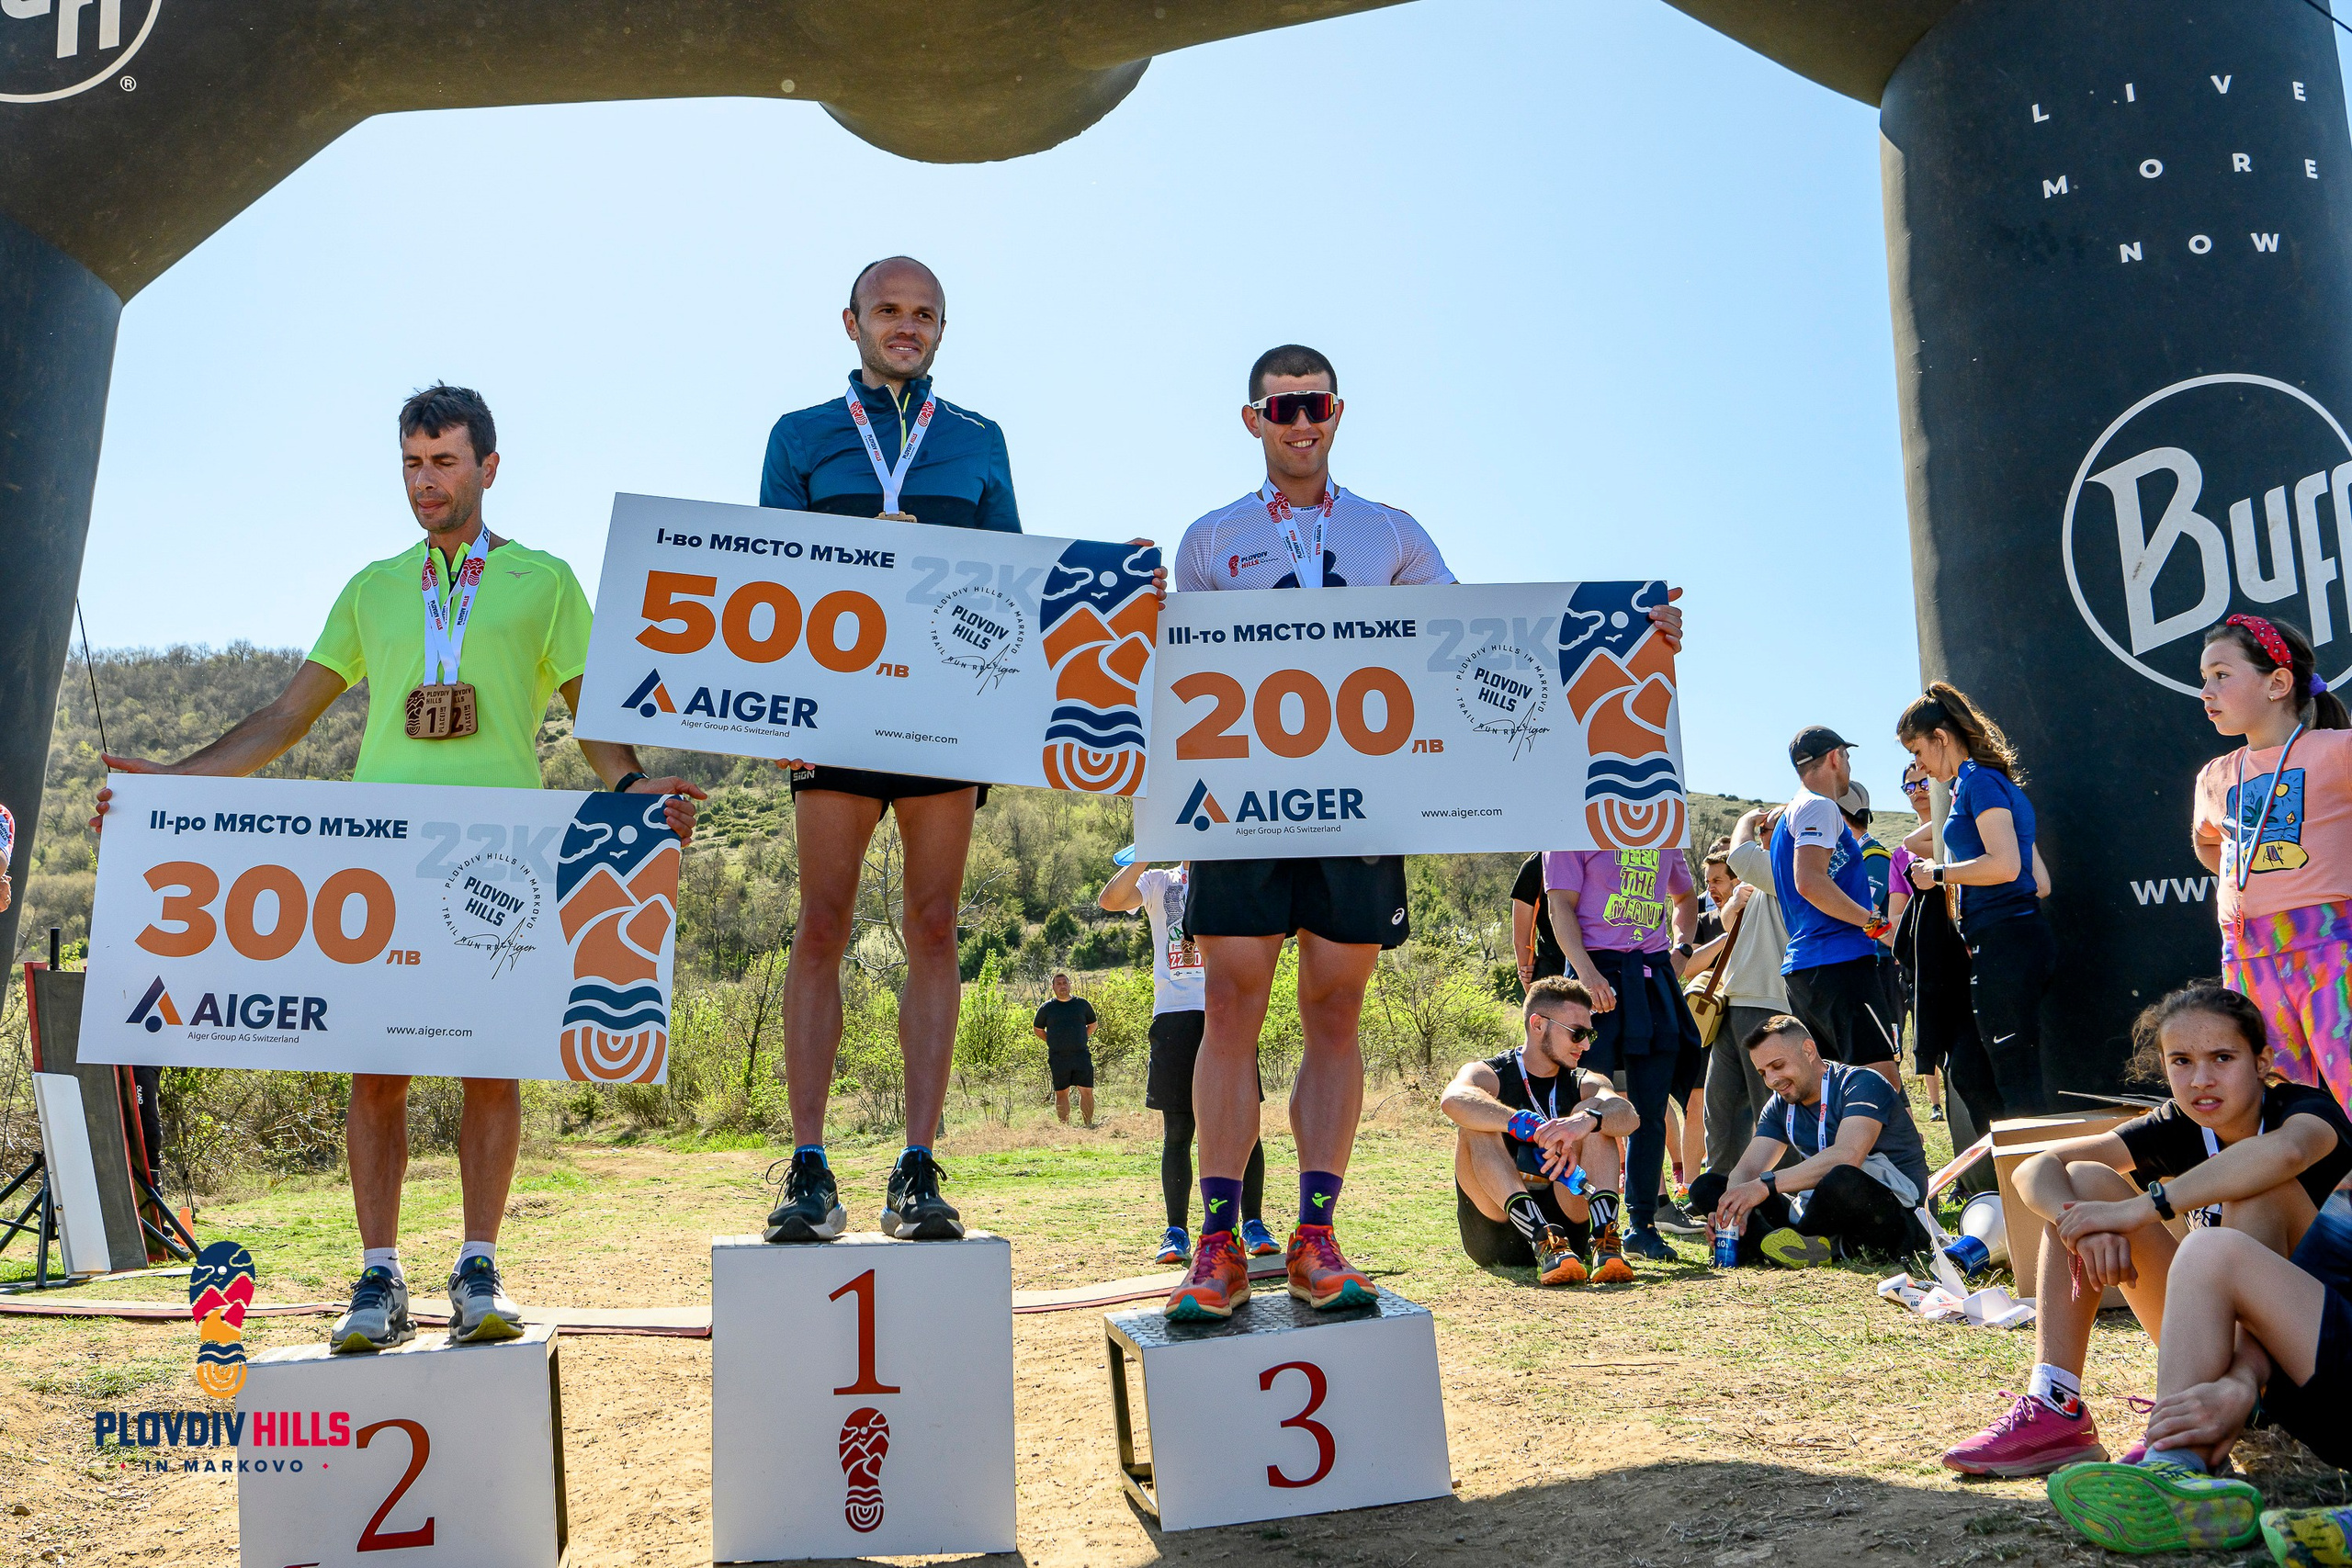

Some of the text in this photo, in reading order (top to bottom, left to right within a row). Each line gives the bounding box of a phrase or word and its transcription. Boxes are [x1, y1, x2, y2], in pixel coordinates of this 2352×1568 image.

[2119, 232, 2280, 264] NOW
[709, 533, 804, 558] МЯСТО
[809, 544, 896, 569] МЪЖЕ
[906, 555, 1046, 617] 22K
[635, 570, 910, 678] 500 лв
[933, 586, 1024, 655] PLOVDIV HILLS IN MARKOVO
[951, 604, 1010, 640] PLOVDIV
[952, 623, 991, 650] HILLS
[1233, 622, 1326, 642] МЯСТО
[1333, 619, 1417, 639] МЪЖЕ
[930, 629, 945, 656] TRAIL
[1426, 616, 1559, 672] 22K
[1456, 644, 1548, 713] PLOVDIV HILLS IN MARKOVO
[1474, 667, 1533, 700] PLOVDIV
[683, 686, 819, 729] AIGER
[1170, 666, 1444, 761] 200 лв
[1457, 697, 1476, 724] TRAIL
[1477, 686, 1518, 713] HILLS
[681, 719, 790, 738] Aiger Group AG Switzerland
[875, 728, 958, 745] www.aiger.com
[1236, 787, 1367, 823] AIGER
[1421, 807, 1503, 819] www.aiger.com
[213, 812, 312, 836] МЯСТО
[319, 817, 409, 840] МЪЖЕ
[1236, 827, 1257, 837] Aiger
[1258, 827, 1282, 836] Group
[1296, 824, 1341, 833] Switzerland
[416, 821, 563, 885] 22K
[445, 852, 541, 930] PLOVDIV HILLS IN MARKOVO
[464, 876, 526, 914] PLOVDIV
[2130, 875, 2219, 905] ww
[134, 861, 422, 965] 300 лв
[442, 907, 458, 936] TRAIL
[465, 897, 506, 927] HILLS
[188, 992, 328, 1032] AIGER
[187, 1032, 300, 1043] Aiger Group AG Switzerland
[386, 1024, 473, 1038] www.aiger.com
[828, 1269, 901, 1395] 1
[1258, 1360, 1336, 1489] 3
[356, 1418, 435, 1552] 2
